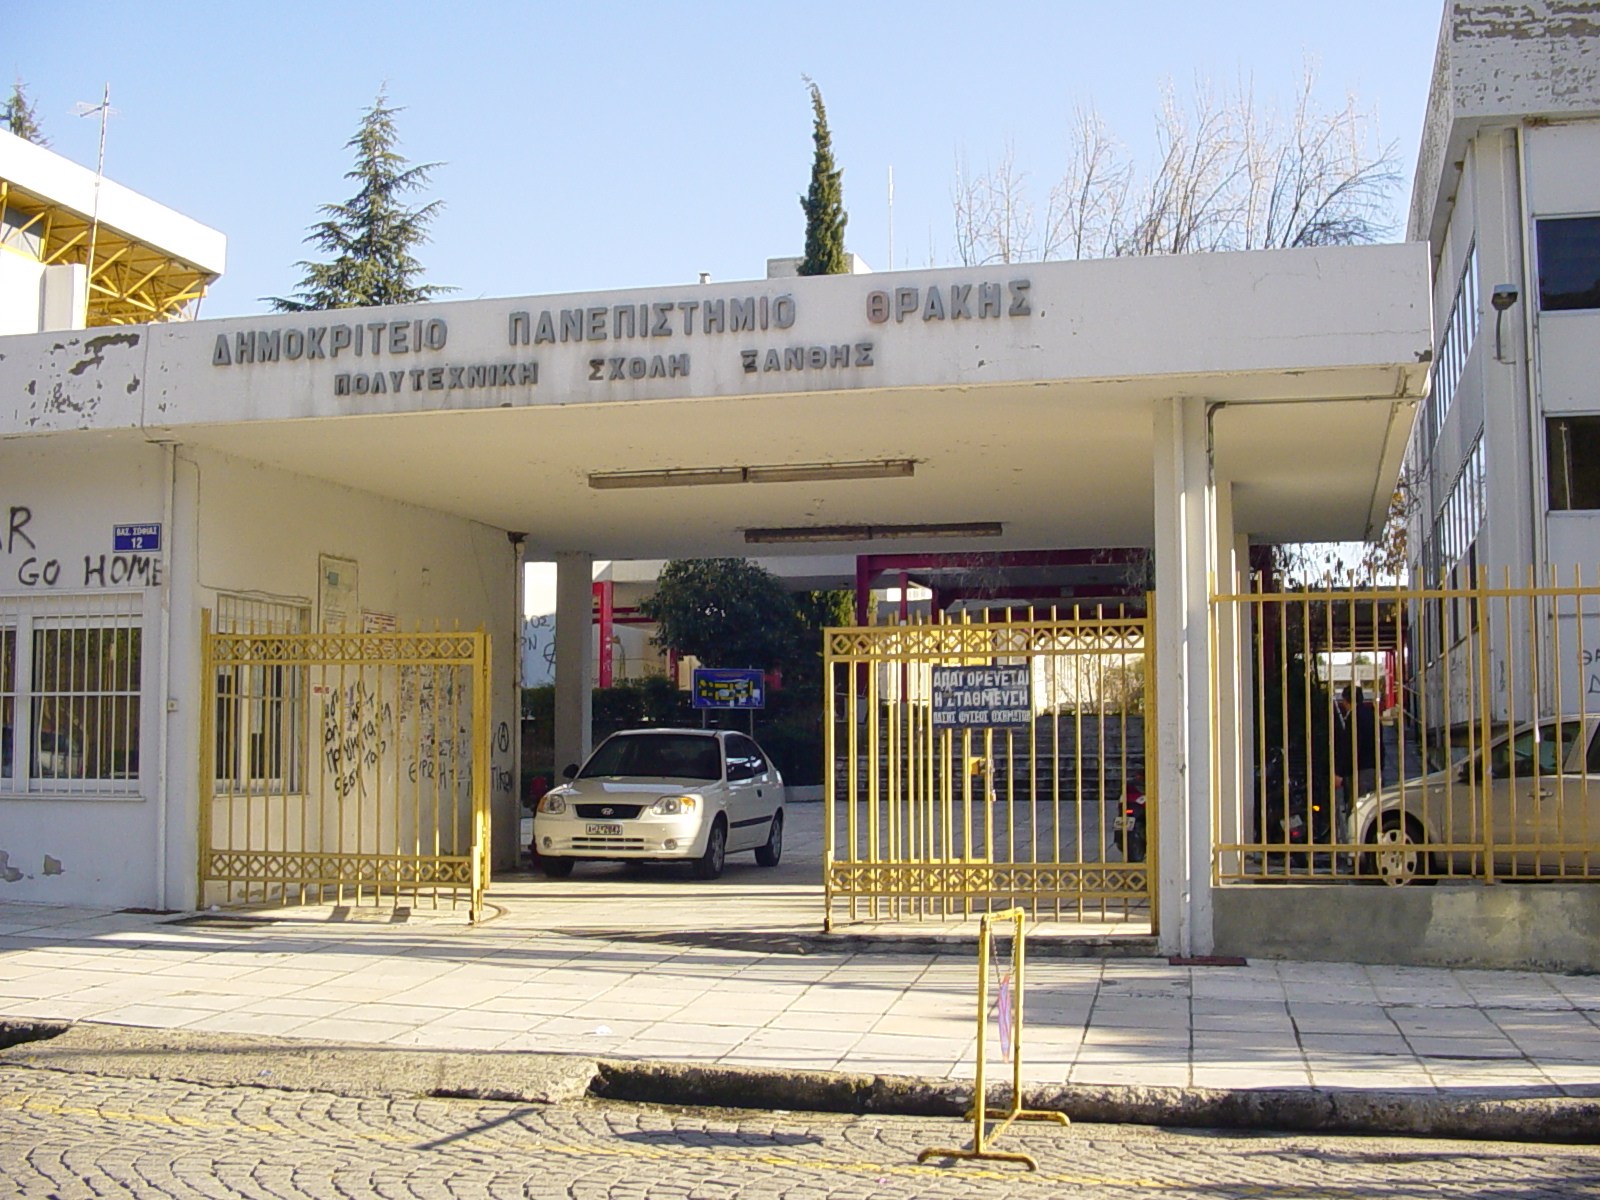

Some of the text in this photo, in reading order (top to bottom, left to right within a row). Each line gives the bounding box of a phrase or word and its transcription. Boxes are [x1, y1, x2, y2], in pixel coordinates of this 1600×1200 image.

[212, 279, 1032, 366] ΔΗΜΟΚΡΙΤΕΙΟ ΠΑΝΕΠΙΣΤΗΜΙΟ ΘΡΑΚΗΣ
[333, 342, 874, 396] ΠΟΛΥΤΕΧΝΙΚΗ ΣΧΟΛΗ ΞΑΝΘΗΣ
[131, 537, 143, 549] 12
[18, 554, 163, 587] GO HOME
[934, 691, 943, 707] Η
